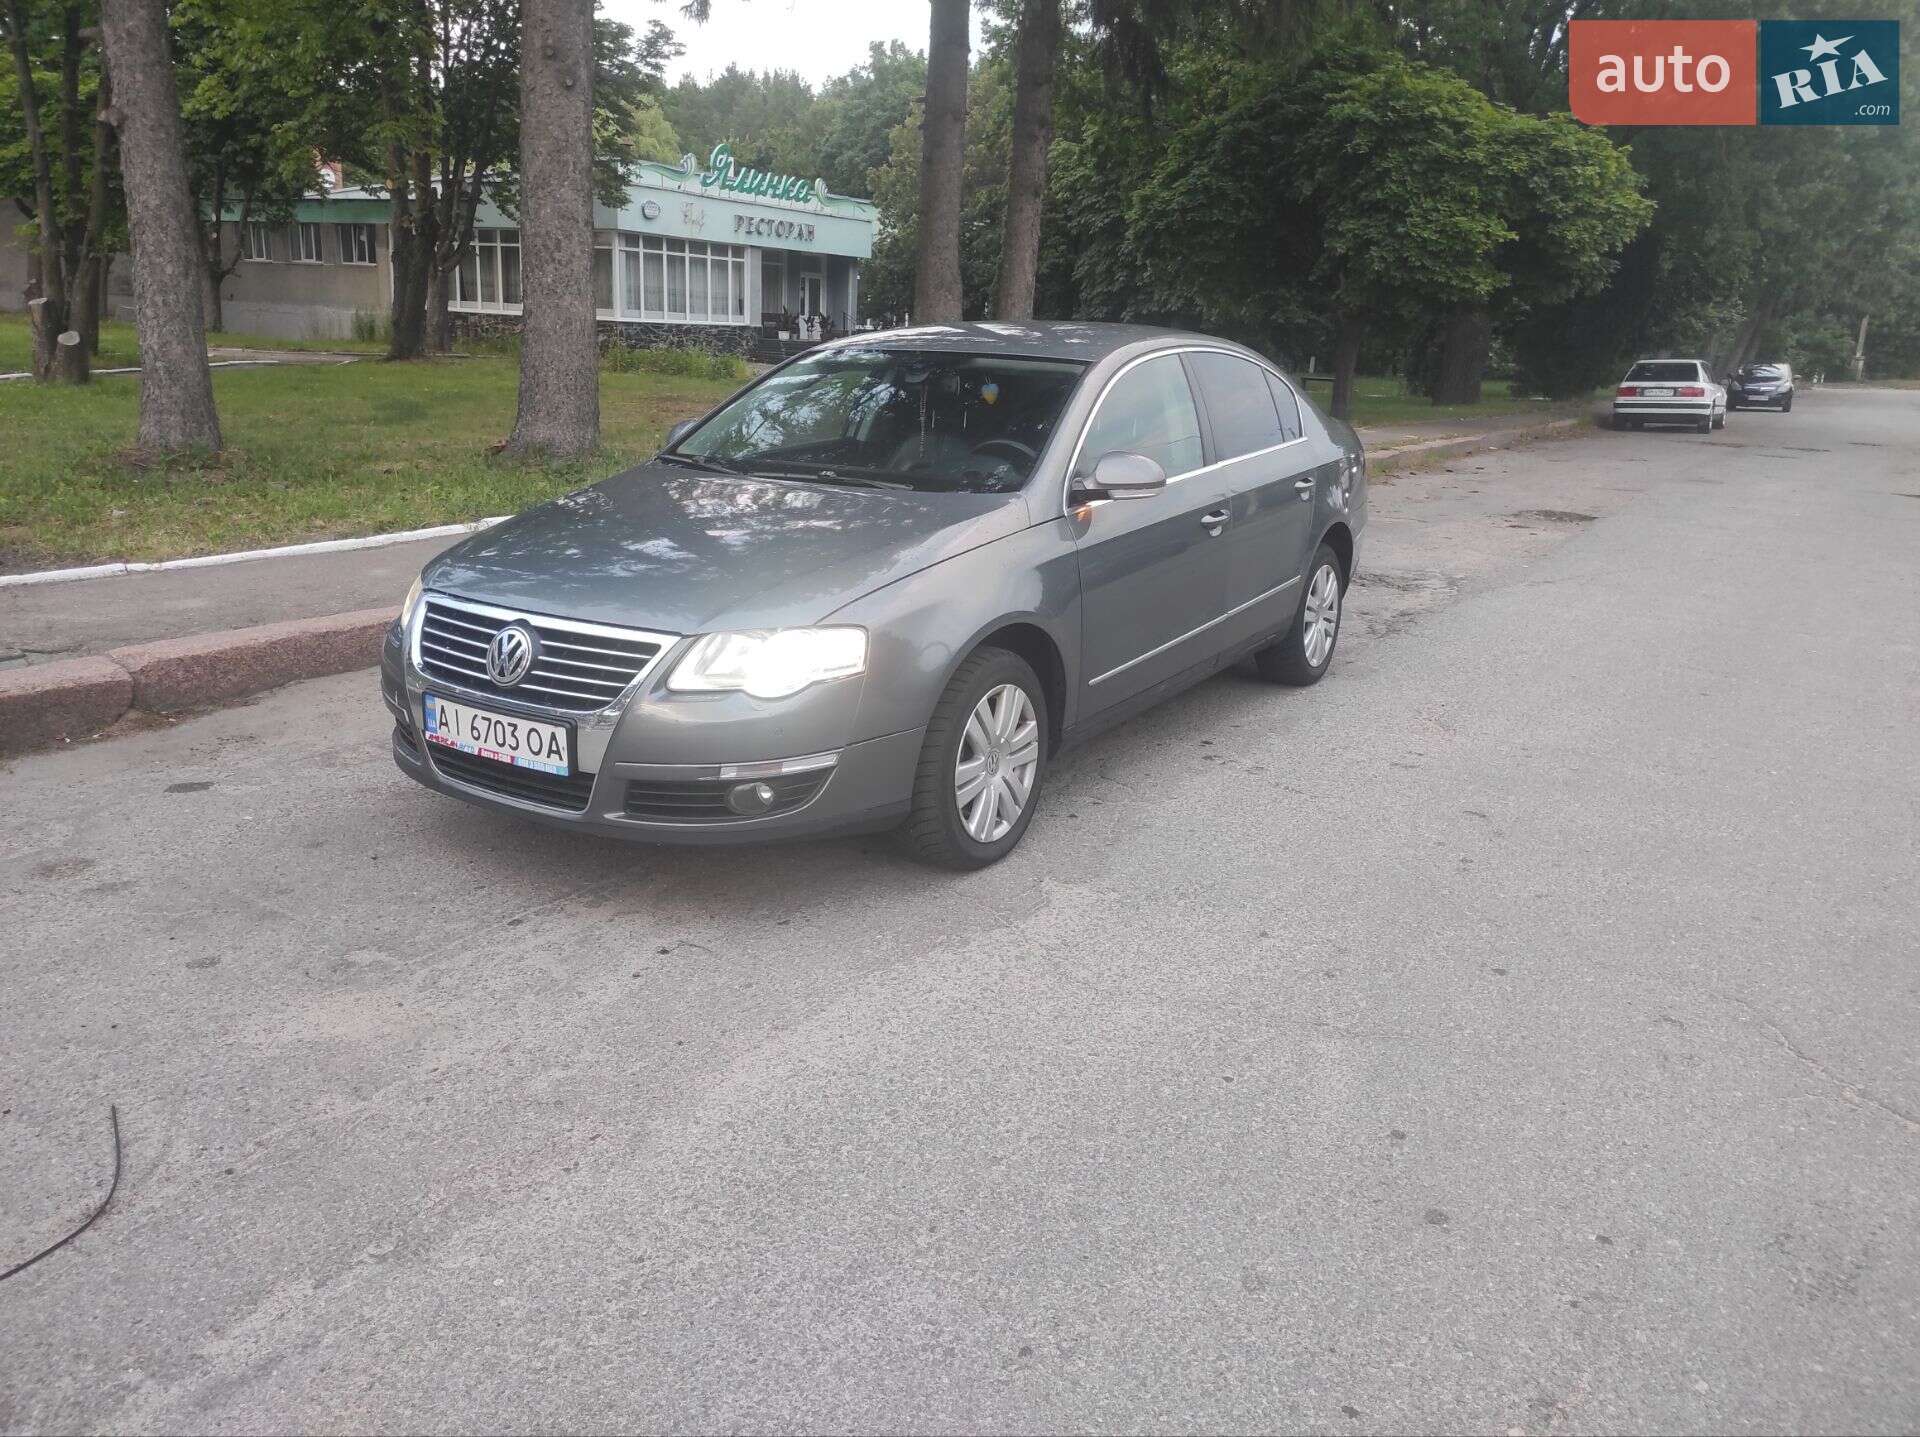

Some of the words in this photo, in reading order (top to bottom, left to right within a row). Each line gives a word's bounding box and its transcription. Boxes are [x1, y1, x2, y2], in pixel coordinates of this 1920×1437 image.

[732, 213, 816, 242] РЕСТОРАН
[470, 713, 520, 752] 6703
[526, 727, 564, 762] OA
